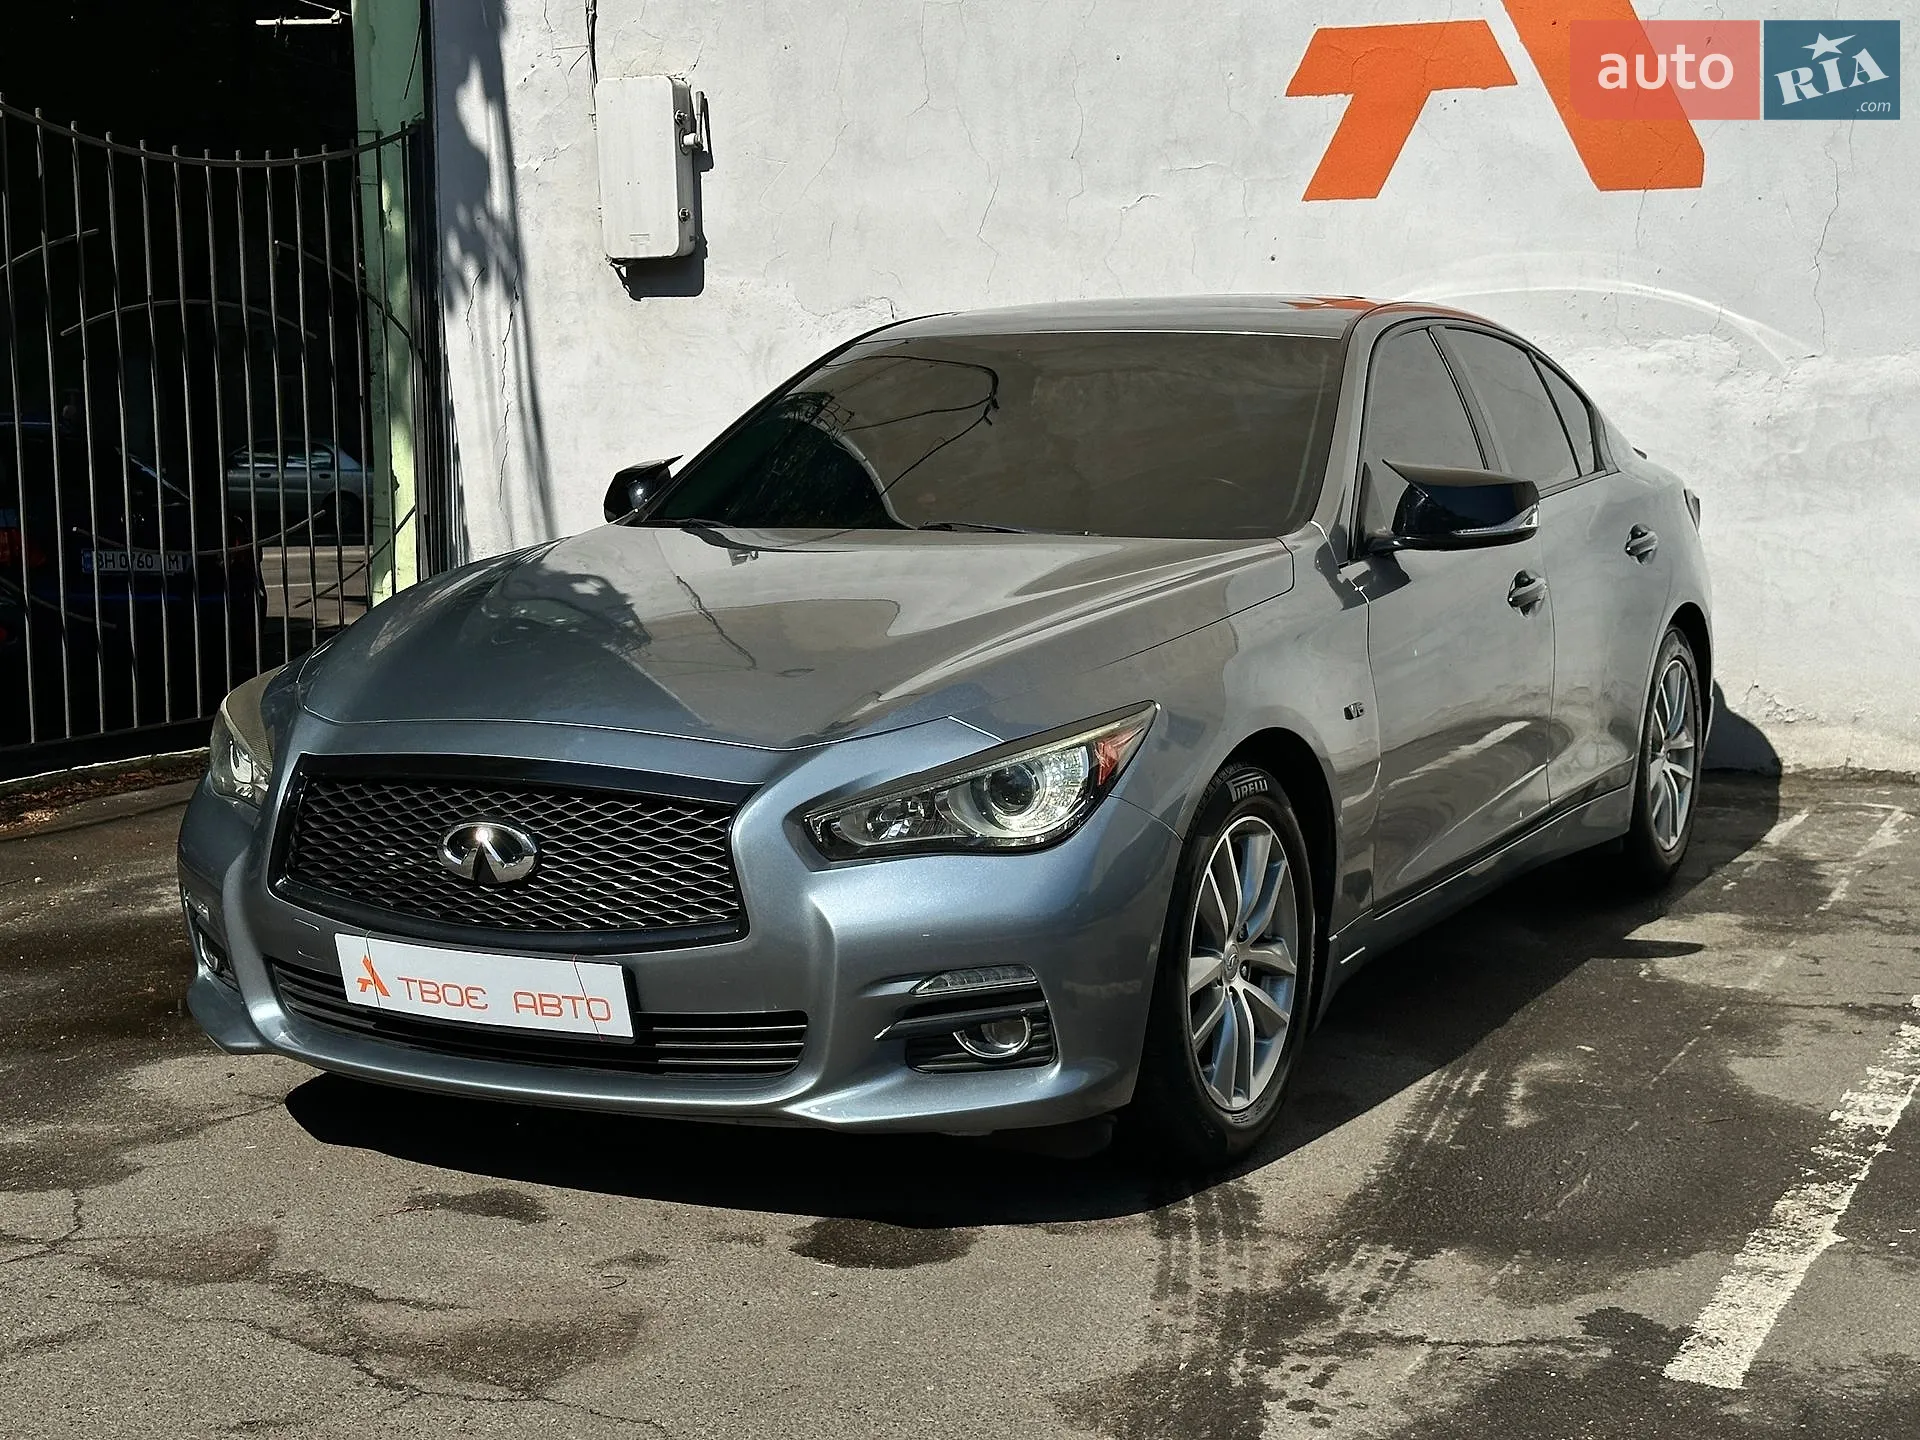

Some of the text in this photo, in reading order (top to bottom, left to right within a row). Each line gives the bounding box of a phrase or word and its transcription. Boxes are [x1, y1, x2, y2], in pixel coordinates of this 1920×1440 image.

[1226, 771, 1269, 802] PIRELLI
[397, 976, 612, 1021] ТВОЄ АВТО
